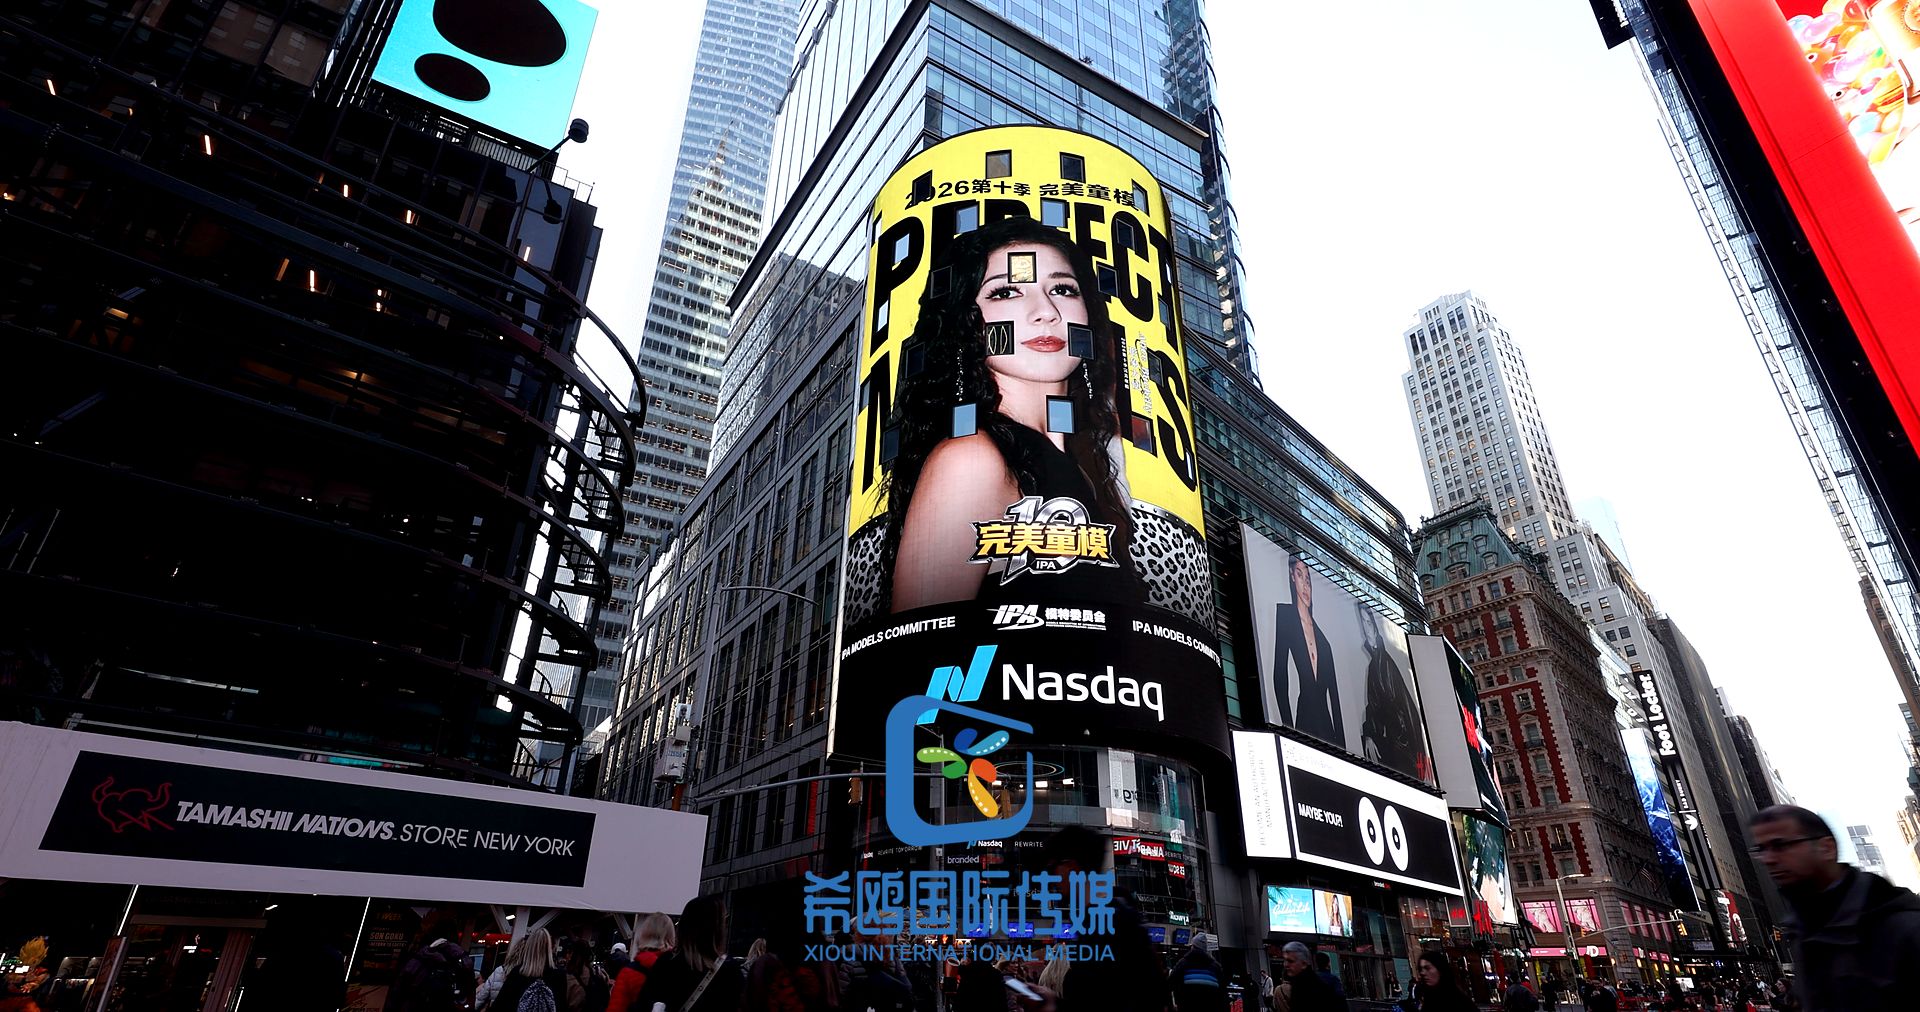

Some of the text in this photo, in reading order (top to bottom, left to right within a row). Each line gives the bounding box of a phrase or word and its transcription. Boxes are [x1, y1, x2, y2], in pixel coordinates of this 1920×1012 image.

[976, 522, 1110, 560] 完美童模
[1035, 560, 1057, 570] IPA
[990, 603, 1043, 629] IPA
[851, 631, 883, 653] MODELS
[884, 615, 956, 640] COMMITTEE
[1132, 619, 1152, 635] IPA
[1153, 624, 1193, 647] MODELS
[1002, 662, 1165, 722] Nasdaq
[1653, 722, 1677, 757] Foot
[1297, 802, 1324, 822] MAYBE
[176, 800, 293, 832] TAMASHII
[399, 823, 468, 849] STORE
[474, 830, 521, 852] NEW
[523, 834, 575, 858] YORK
[947, 855, 980, 864] branded
